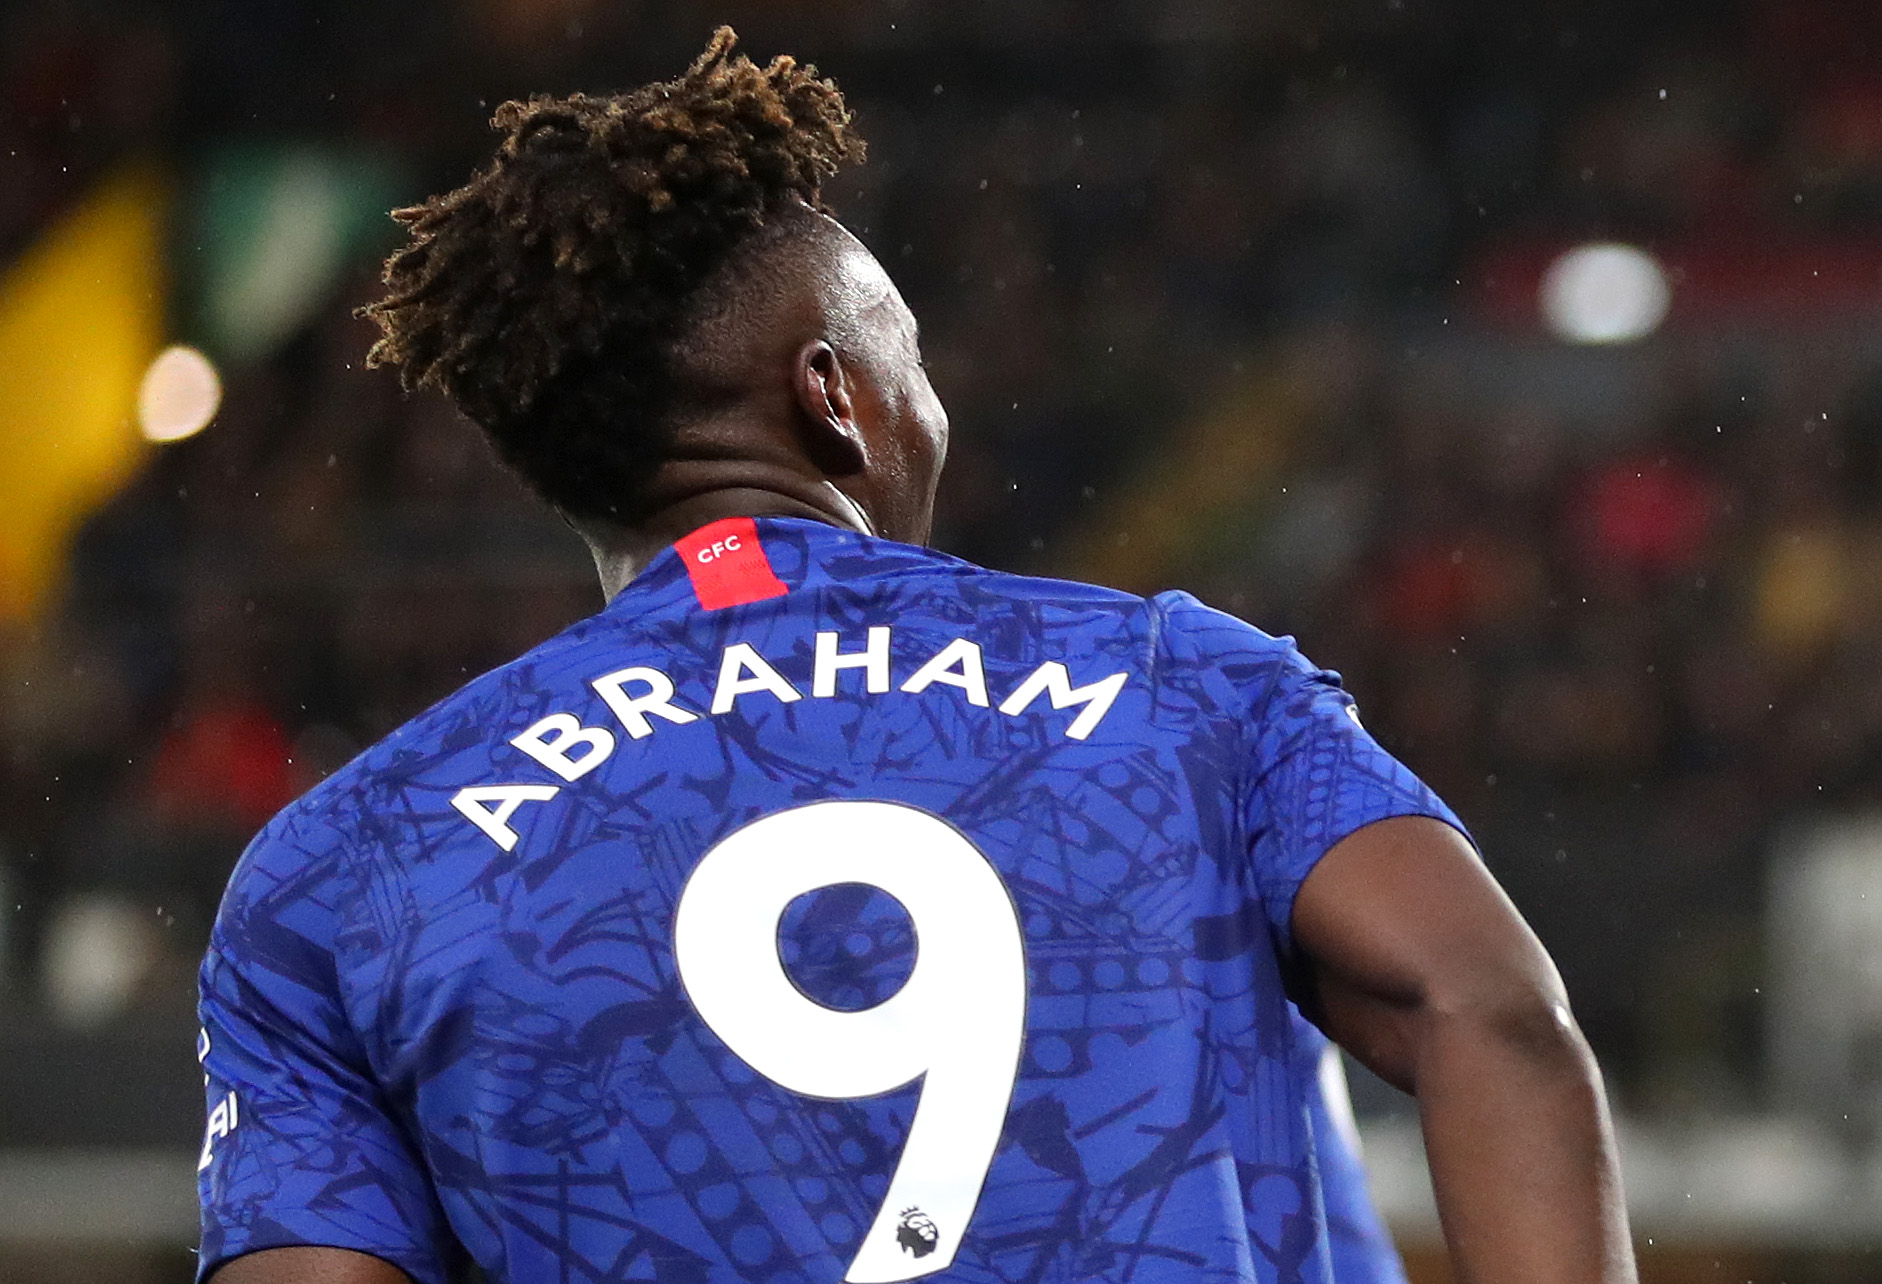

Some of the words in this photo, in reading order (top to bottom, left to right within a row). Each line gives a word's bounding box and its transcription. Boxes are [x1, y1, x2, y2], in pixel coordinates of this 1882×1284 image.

[697, 535, 742, 563] CFC
[448, 625, 1129, 852] ABRAHAM
[675, 801, 1025, 1284] 9
